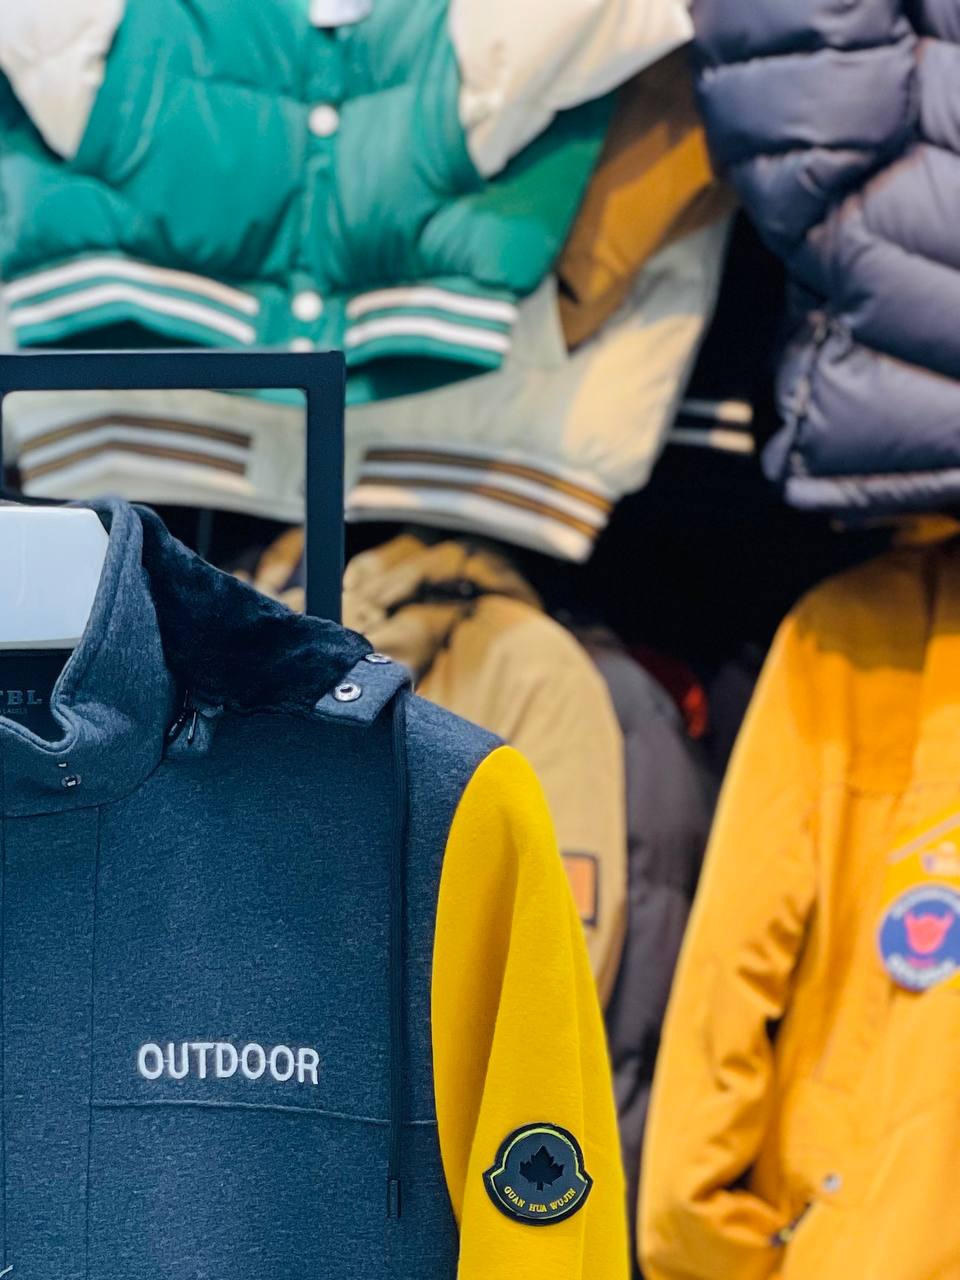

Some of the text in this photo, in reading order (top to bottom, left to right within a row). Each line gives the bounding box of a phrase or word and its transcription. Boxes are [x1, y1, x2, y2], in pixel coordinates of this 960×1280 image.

[139, 1042, 320, 1085] OUTDOOR
[503, 1186, 577, 1213] GUAN HUA WUJIN
